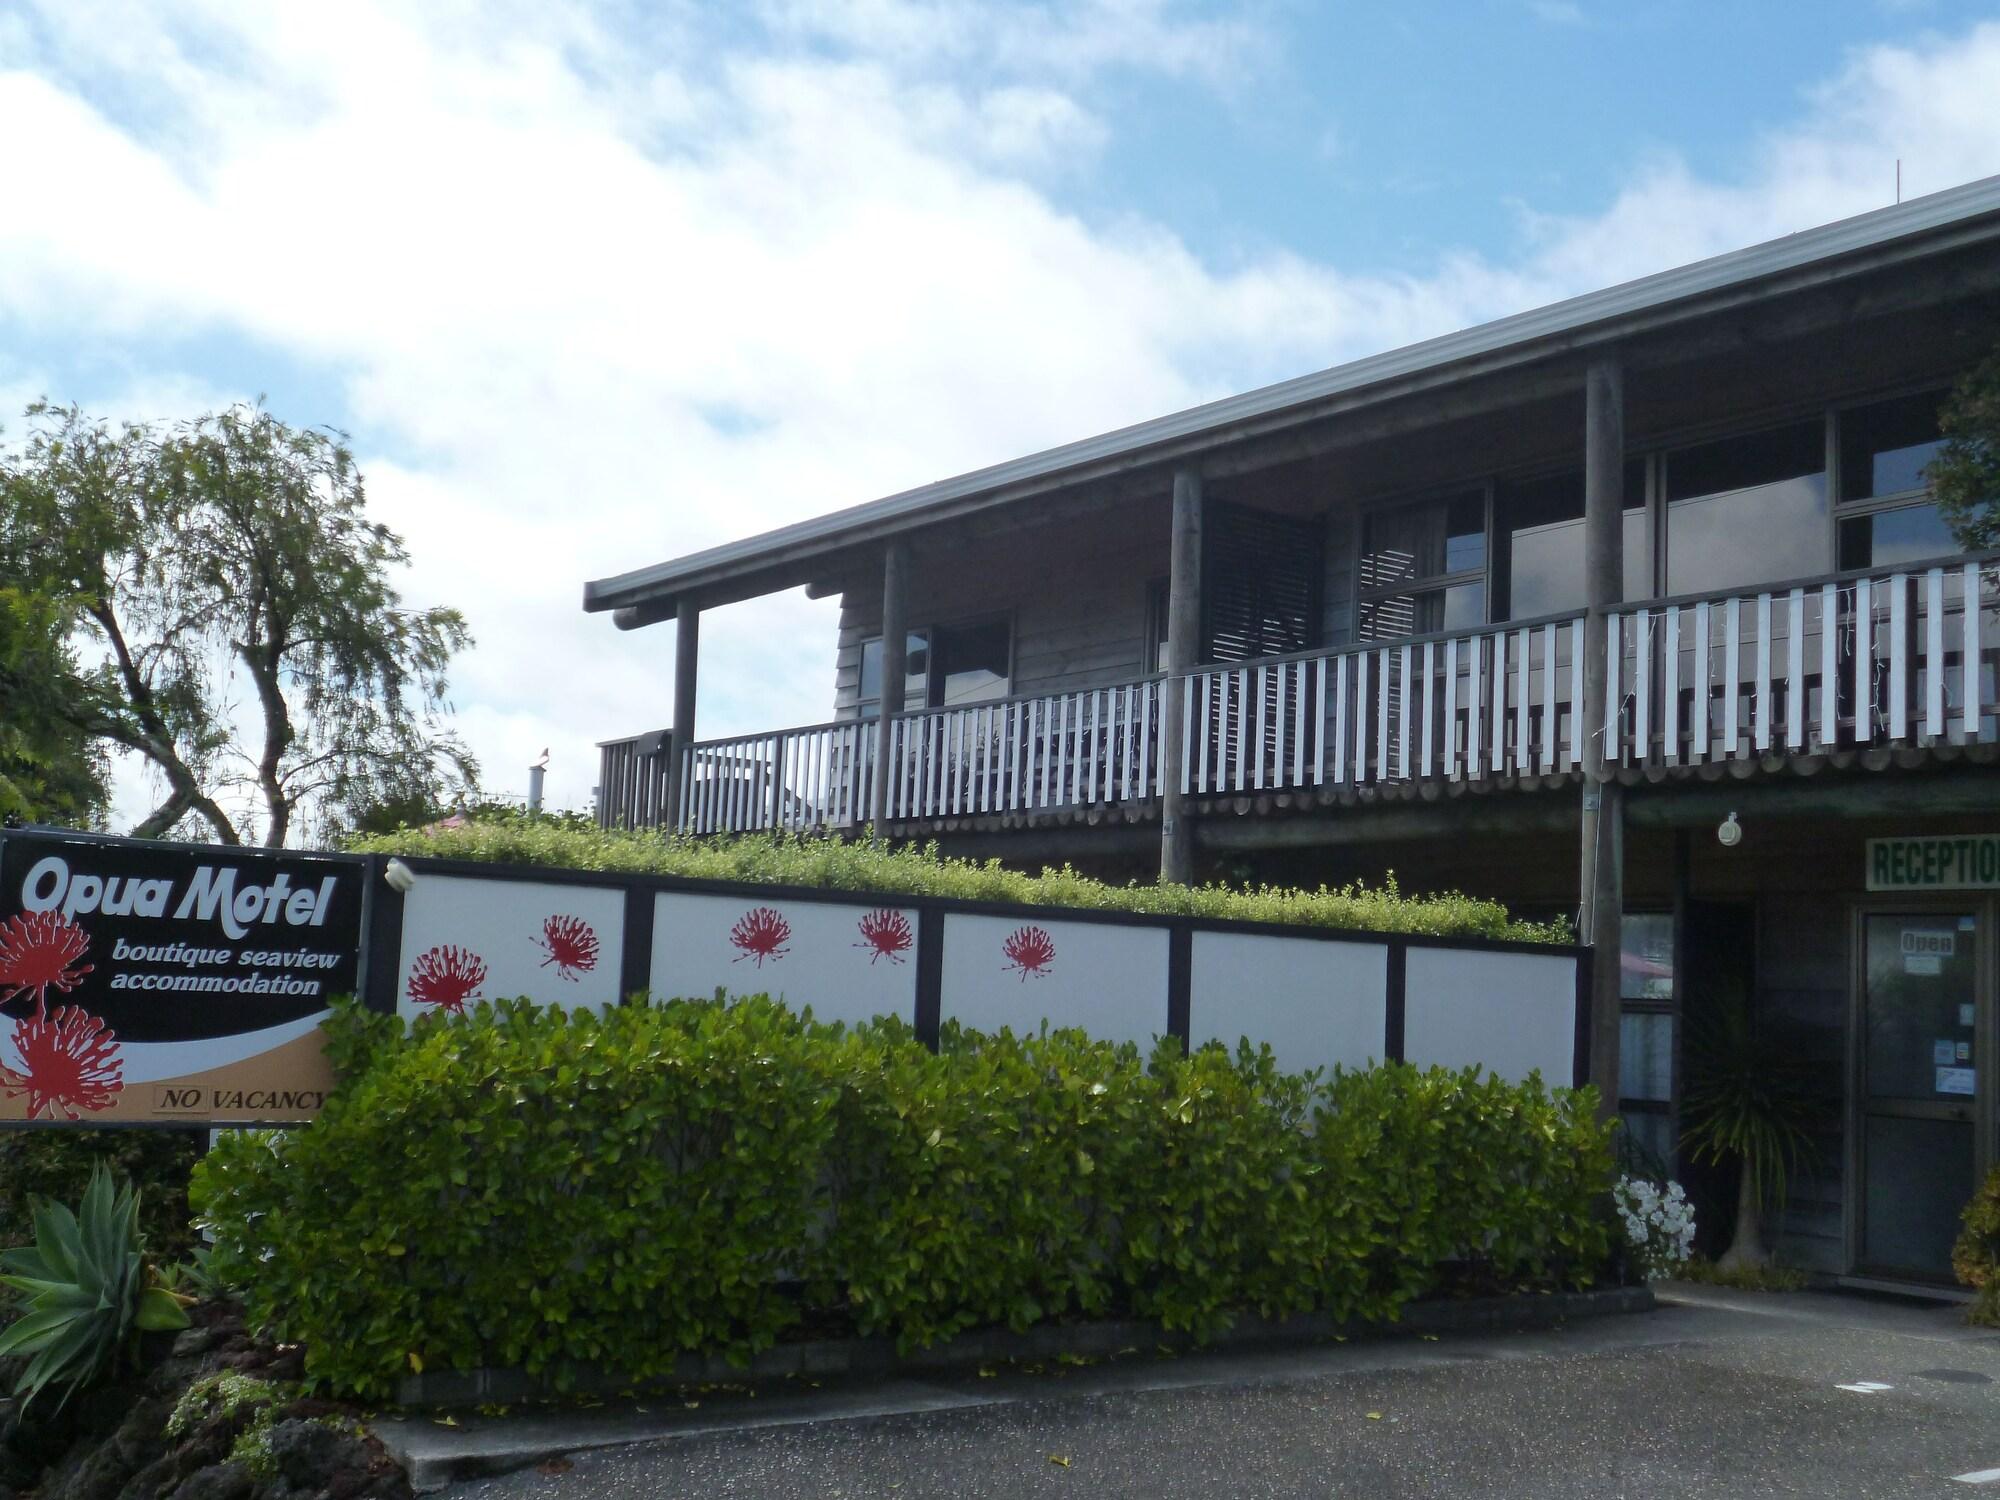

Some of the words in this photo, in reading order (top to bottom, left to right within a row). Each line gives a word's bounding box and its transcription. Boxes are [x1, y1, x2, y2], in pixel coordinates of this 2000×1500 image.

[1873, 840, 2000, 884] RECEPTIO
[22, 857, 174, 927] Opua
[173, 867, 337, 939] Motel
[112, 939, 230, 968] boutique
[238, 951, 340, 968] seaview
[111, 973, 320, 995] accommodation
[161, 1089, 201, 1108] NO
